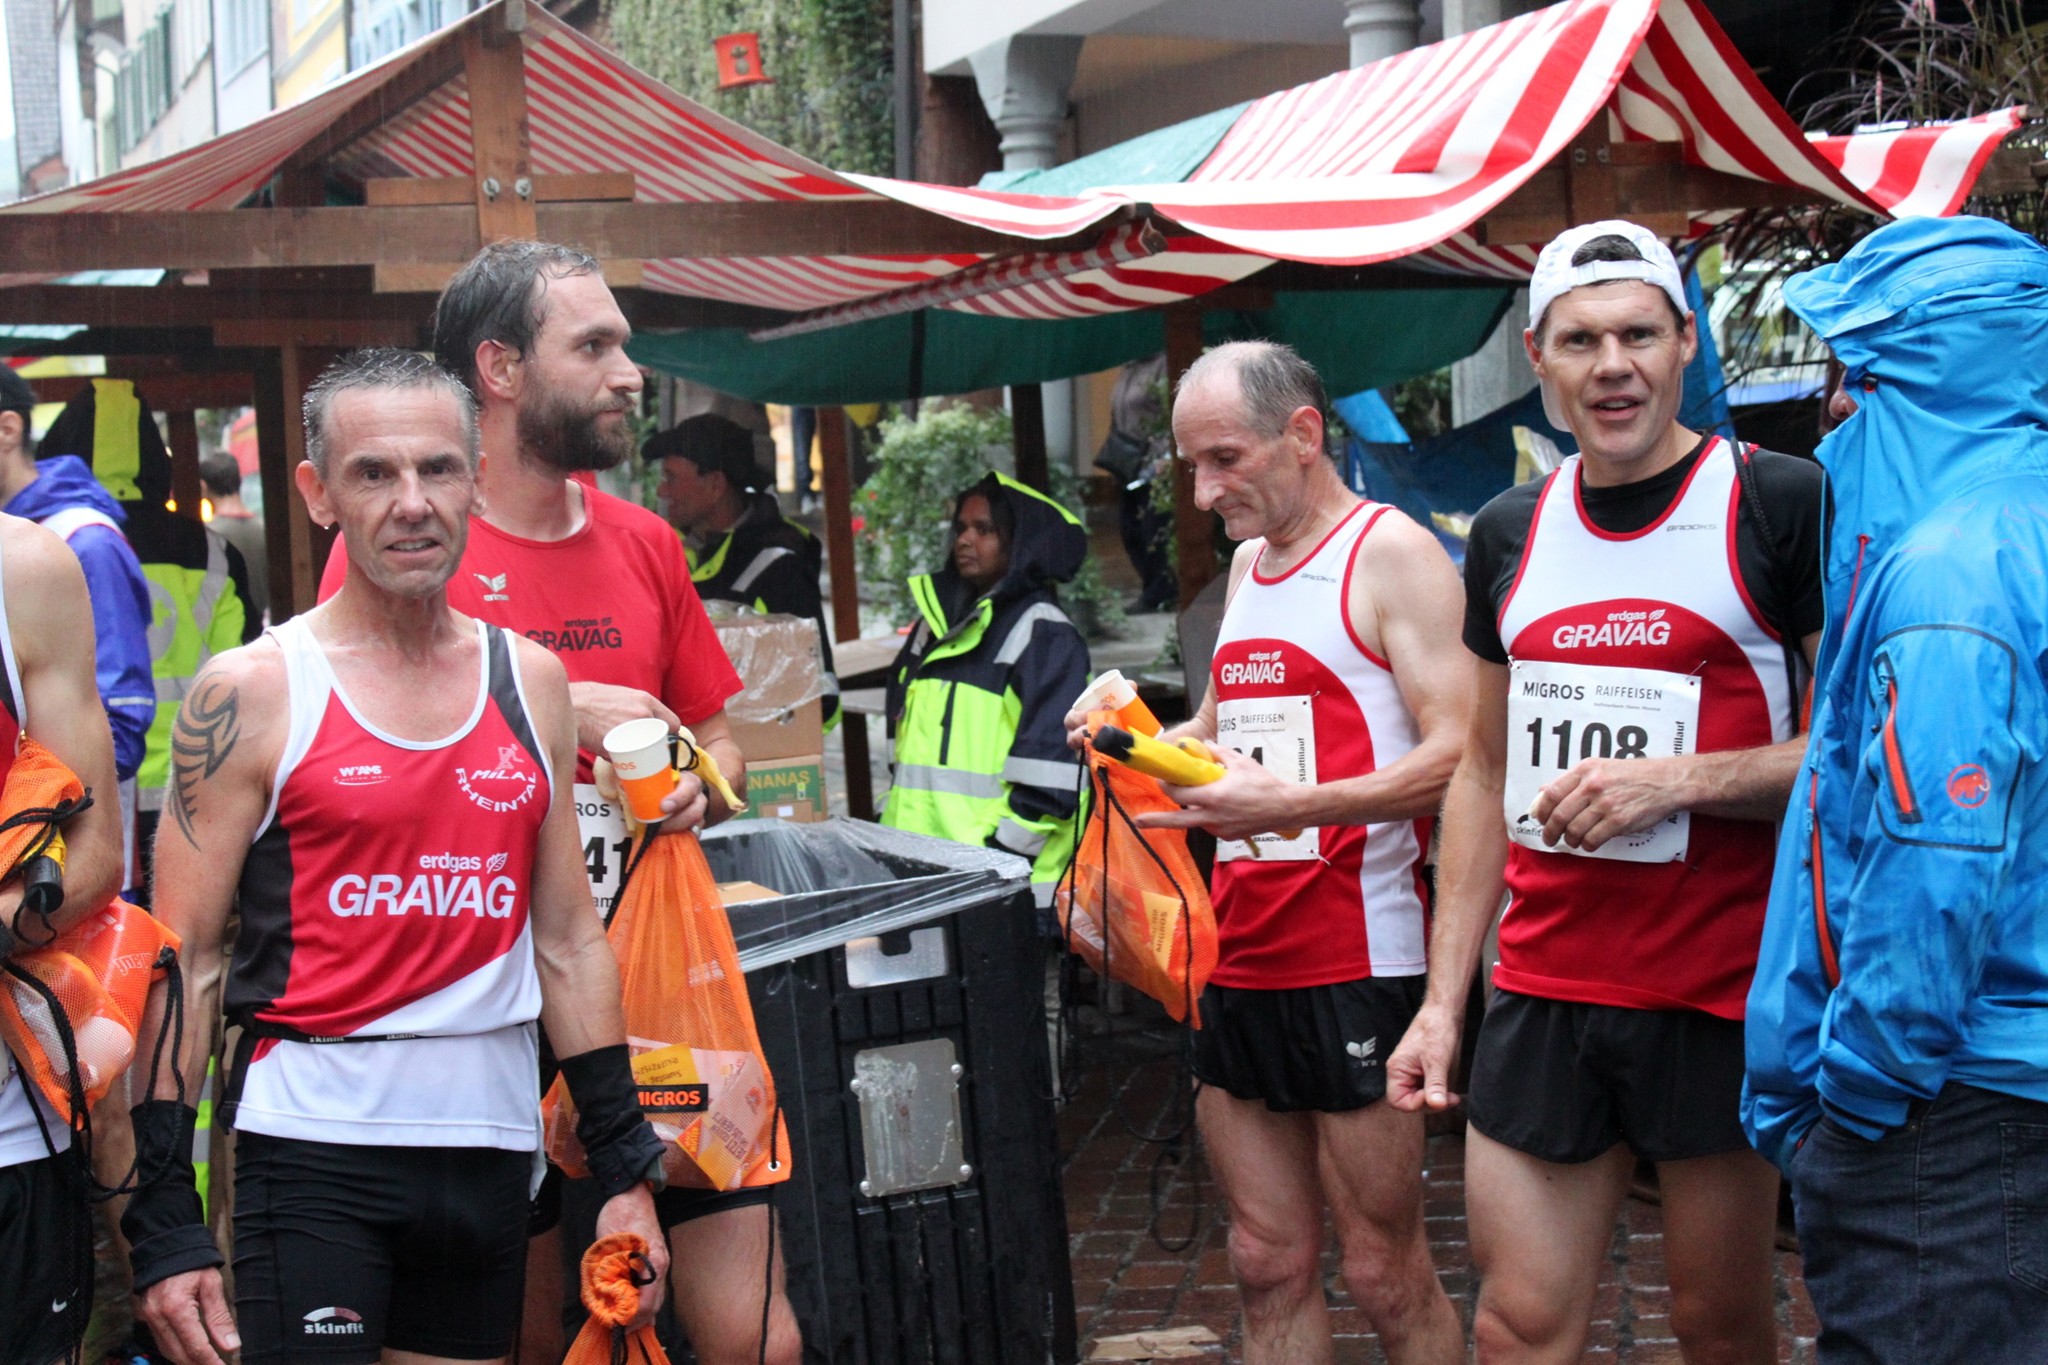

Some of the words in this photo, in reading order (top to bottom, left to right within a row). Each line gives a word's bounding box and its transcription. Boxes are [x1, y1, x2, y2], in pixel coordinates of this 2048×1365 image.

[564, 618, 598, 628] erdgas
[1607, 609, 1647, 622] erdgas
[525, 628, 622, 651] GRAVAG
[1552, 621, 1671, 649] GRAVAG
[1221, 662, 1286, 685] GRAVAG
[1522, 681, 1584, 701] MIGROS
[1596, 684, 1662, 700] RAIFFEISEN
[1218, 717, 1237, 732] GROS
[1241, 714, 1285, 724] RAIFFEISEN
[1526, 717, 1648, 770] 1108
[455, 768, 536, 812] RHEINTAL
[747, 770, 810, 790] NANAS
[419, 852, 481, 873] erdgas
[328, 874, 517, 918] GRAVAG
[304, 1323, 364, 1334] skinfit
